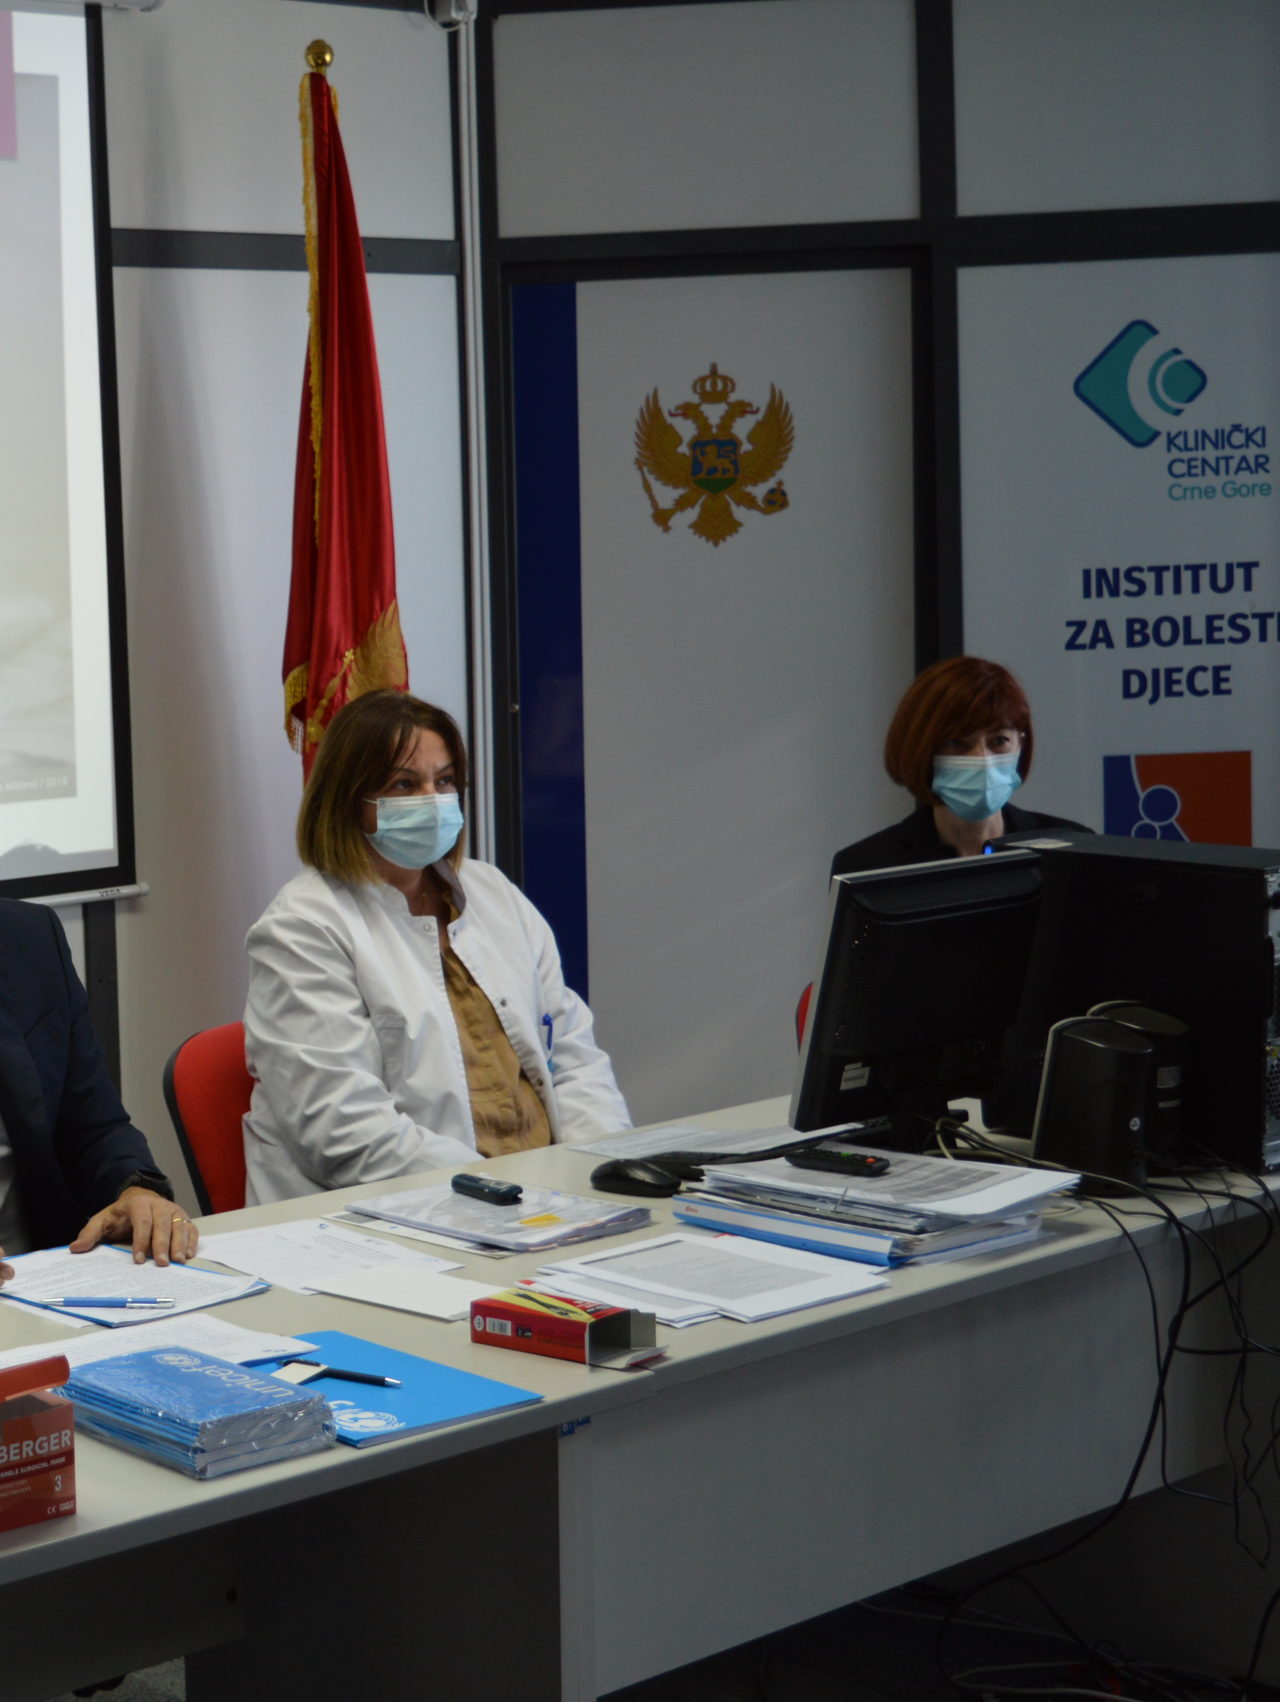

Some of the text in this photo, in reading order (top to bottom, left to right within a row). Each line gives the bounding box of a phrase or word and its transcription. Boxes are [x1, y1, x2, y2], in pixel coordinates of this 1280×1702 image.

[1167, 424, 1267, 453] KLINIČKI
[1167, 453, 1271, 480] CENTAR
[1168, 479, 1272, 501] Crne Gore
[1082, 561, 1260, 600] INSTITUT
[1064, 619, 1115, 652] ZA
[1122, 664, 1233, 705] DJECE
[180, 1364, 296, 1399] unicef
[20, 1460, 49, 1474] SURGICAL
[50, 1456, 66, 1467] MASK
[54, 1474, 62, 1492] 3
